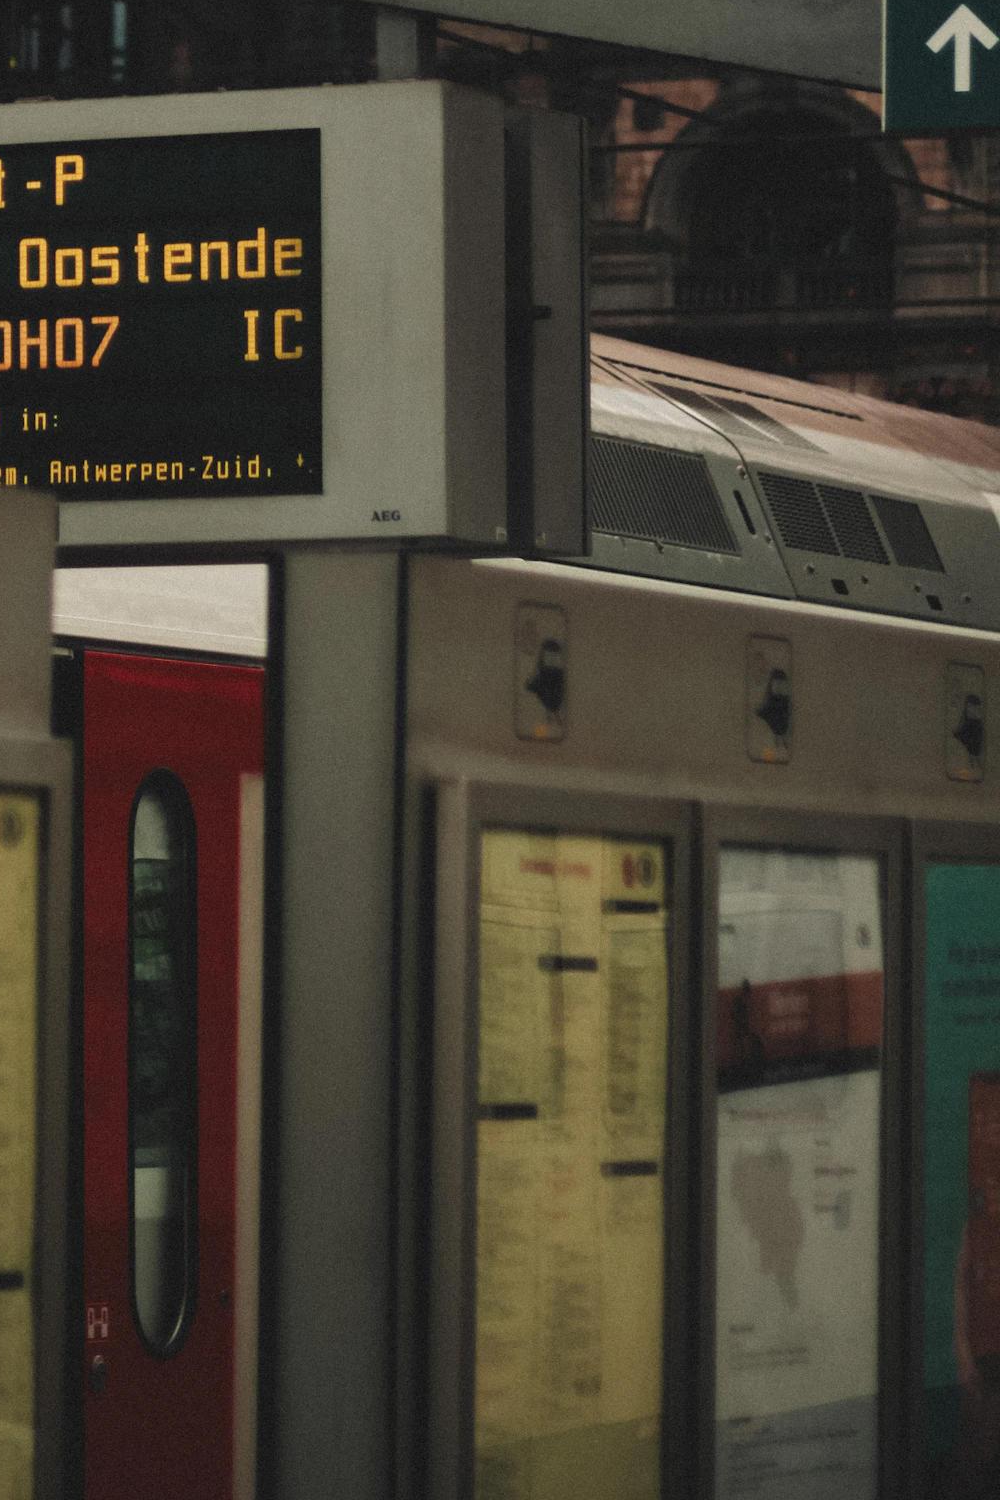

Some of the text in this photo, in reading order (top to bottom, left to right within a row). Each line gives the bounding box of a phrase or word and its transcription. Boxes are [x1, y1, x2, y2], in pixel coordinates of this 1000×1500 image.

[19, 227, 303, 289] Oostende
[244, 308, 303, 361] IC
[22, 408, 58, 431] in:
[371, 510, 401, 522] AEG
